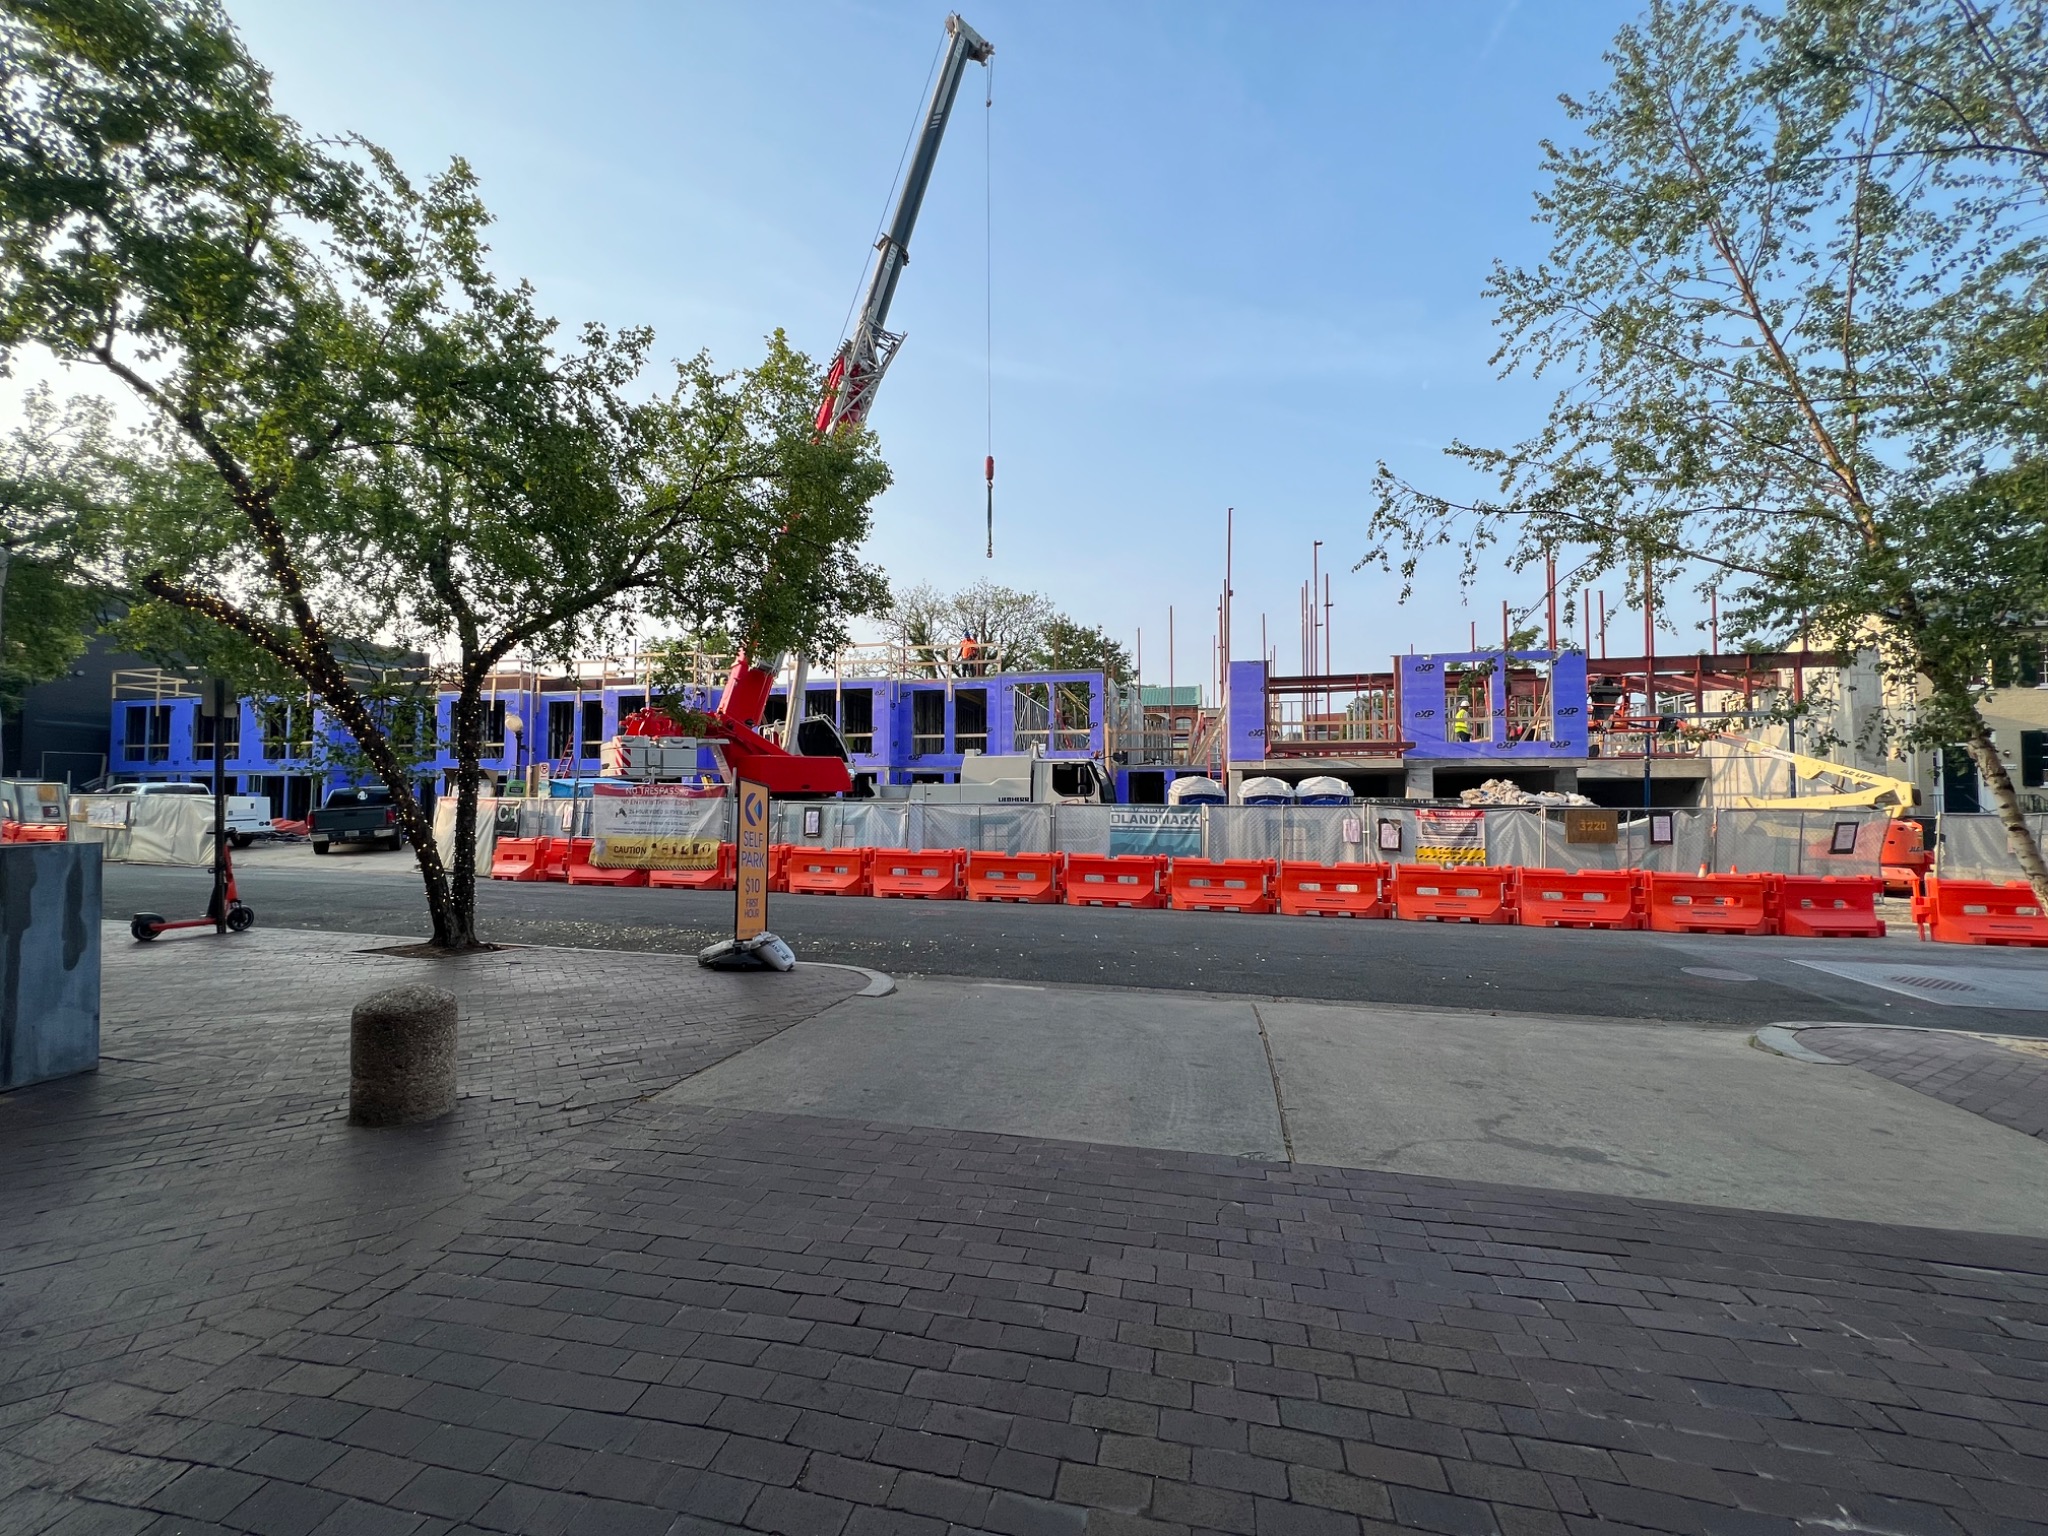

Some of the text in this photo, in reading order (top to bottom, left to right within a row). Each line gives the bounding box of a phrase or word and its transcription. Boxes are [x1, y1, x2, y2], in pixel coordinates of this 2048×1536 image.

[1415, 663, 1435, 673] eXP
[1415, 709, 1435, 719] eXP
[1557, 707, 1578, 716] eXP
[1496, 741, 1518, 749] eXP
[1550, 740, 1571, 749] eXP
[625, 787, 689, 797] NO TRESPASSING
[1121, 814, 1200, 825] LANDMARK
[1579, 820, 1607, 831] 3220
[743, 830, 764, 848] SELF
[613, 845, 647, 855] CAUTION
[741, 851, 765, 869] PARK
[745, 878, 760, 895] $10
[745, 898, 759, 908] FIRST
[744, 909, 760, 918] HOUR
